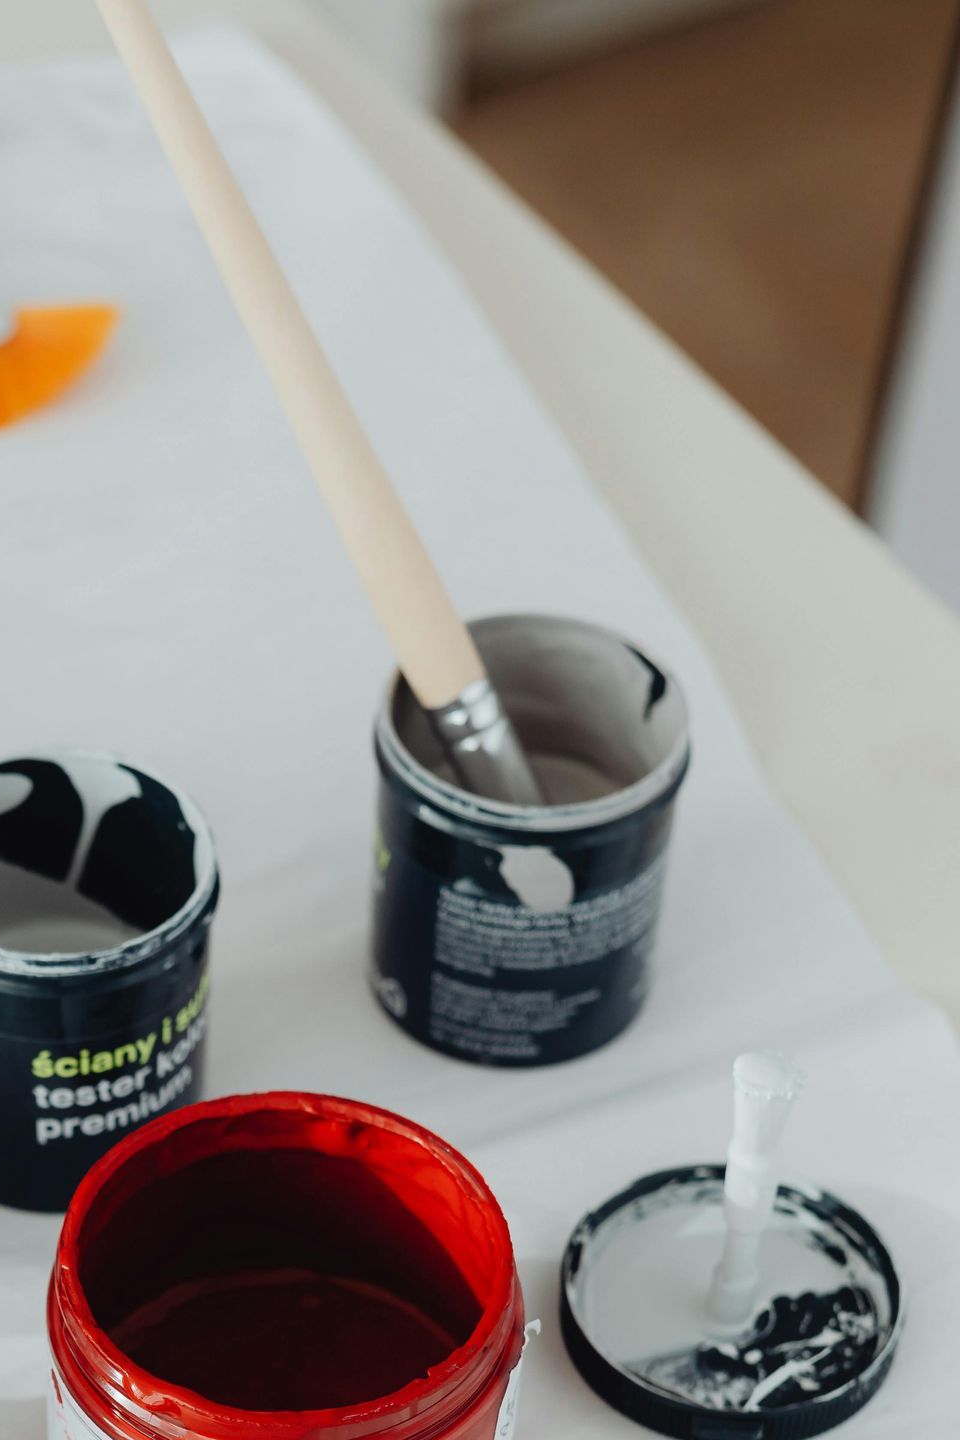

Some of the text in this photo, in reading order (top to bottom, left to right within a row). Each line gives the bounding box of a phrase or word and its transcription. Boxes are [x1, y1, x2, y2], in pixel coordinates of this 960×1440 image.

[31, 1031, 158, 1079] ściany
[161, 1015, 173, 1045] i
[32, 1064, 152, 1109] tester
[35, 1064, 192, 1146] premium
